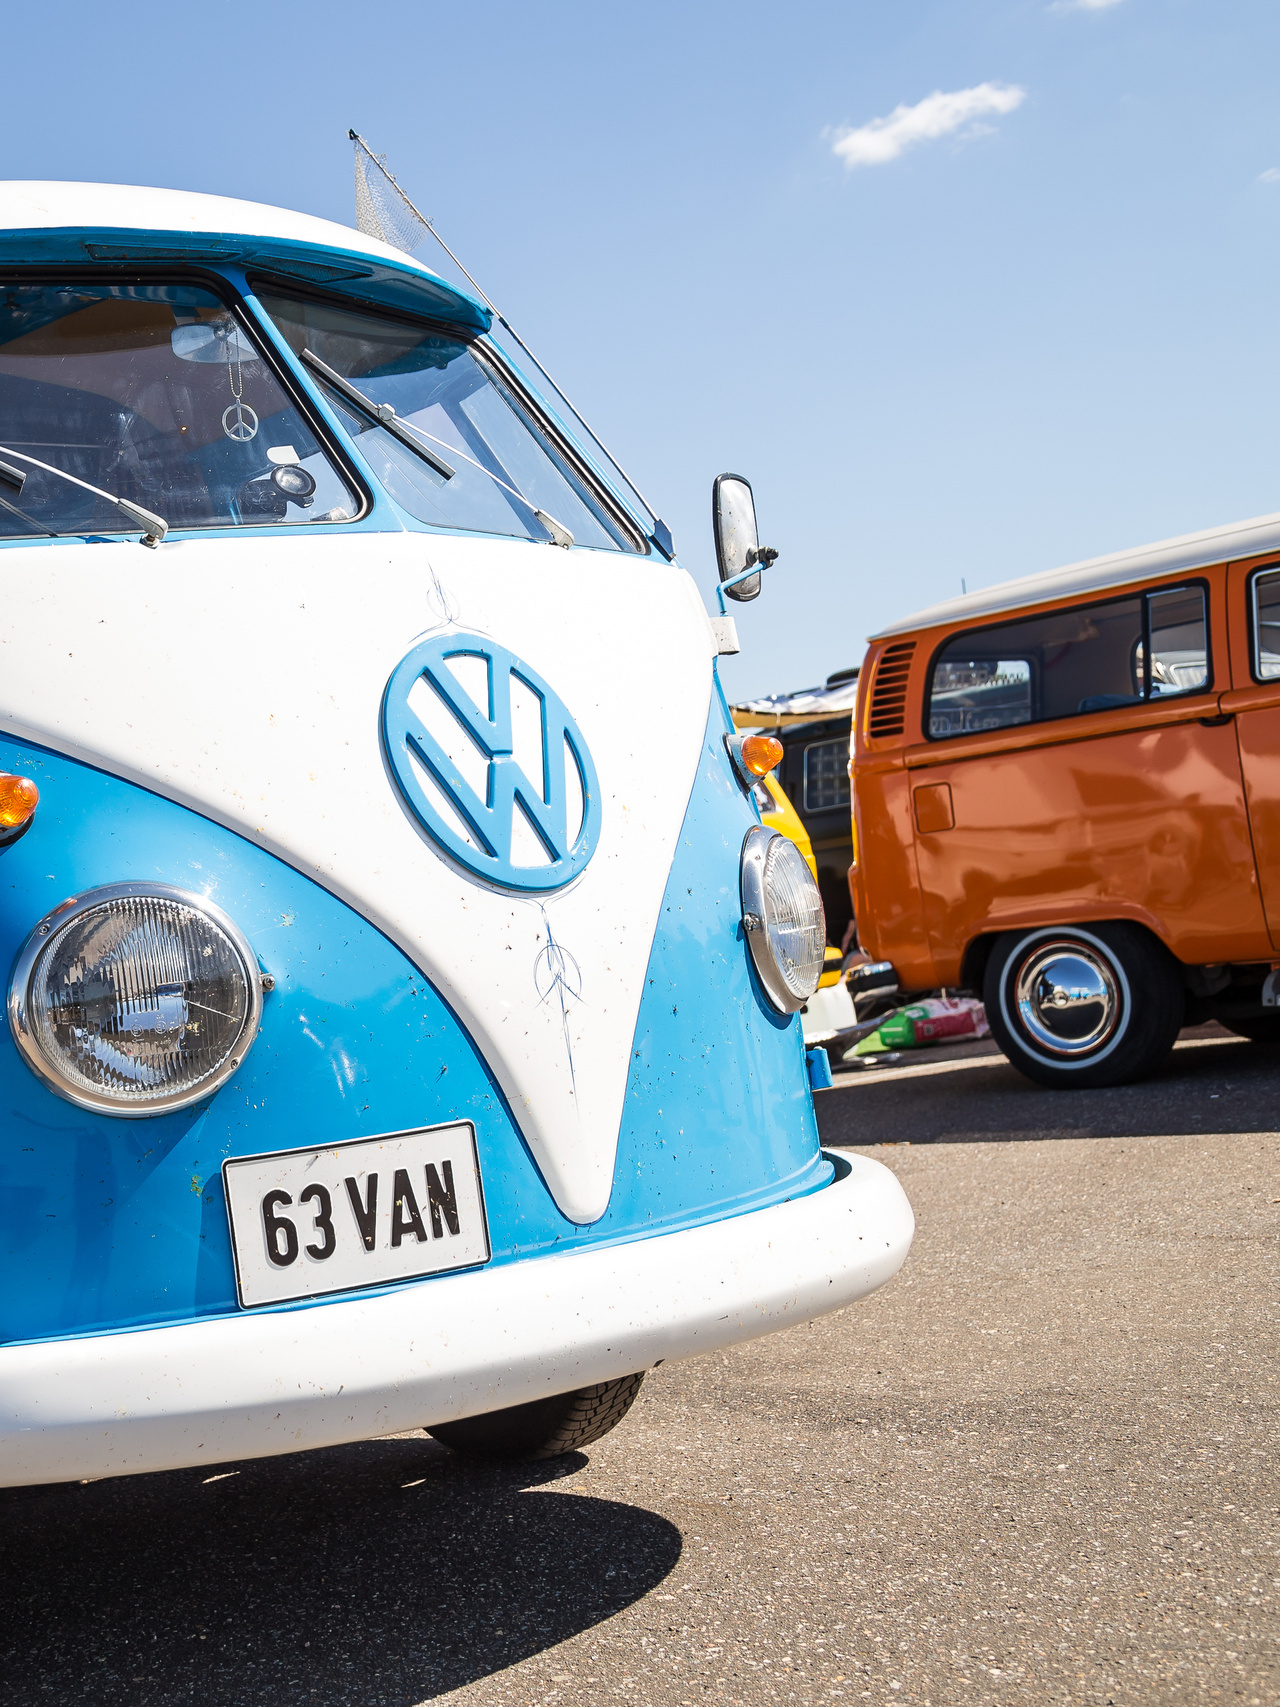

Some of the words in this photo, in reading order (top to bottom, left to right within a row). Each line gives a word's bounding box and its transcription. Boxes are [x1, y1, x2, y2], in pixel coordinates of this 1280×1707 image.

[382, 632, 602, 891] VW
[261, 1183, 336, 1267] 63
[345, 1159, 461, 1251] VAN
